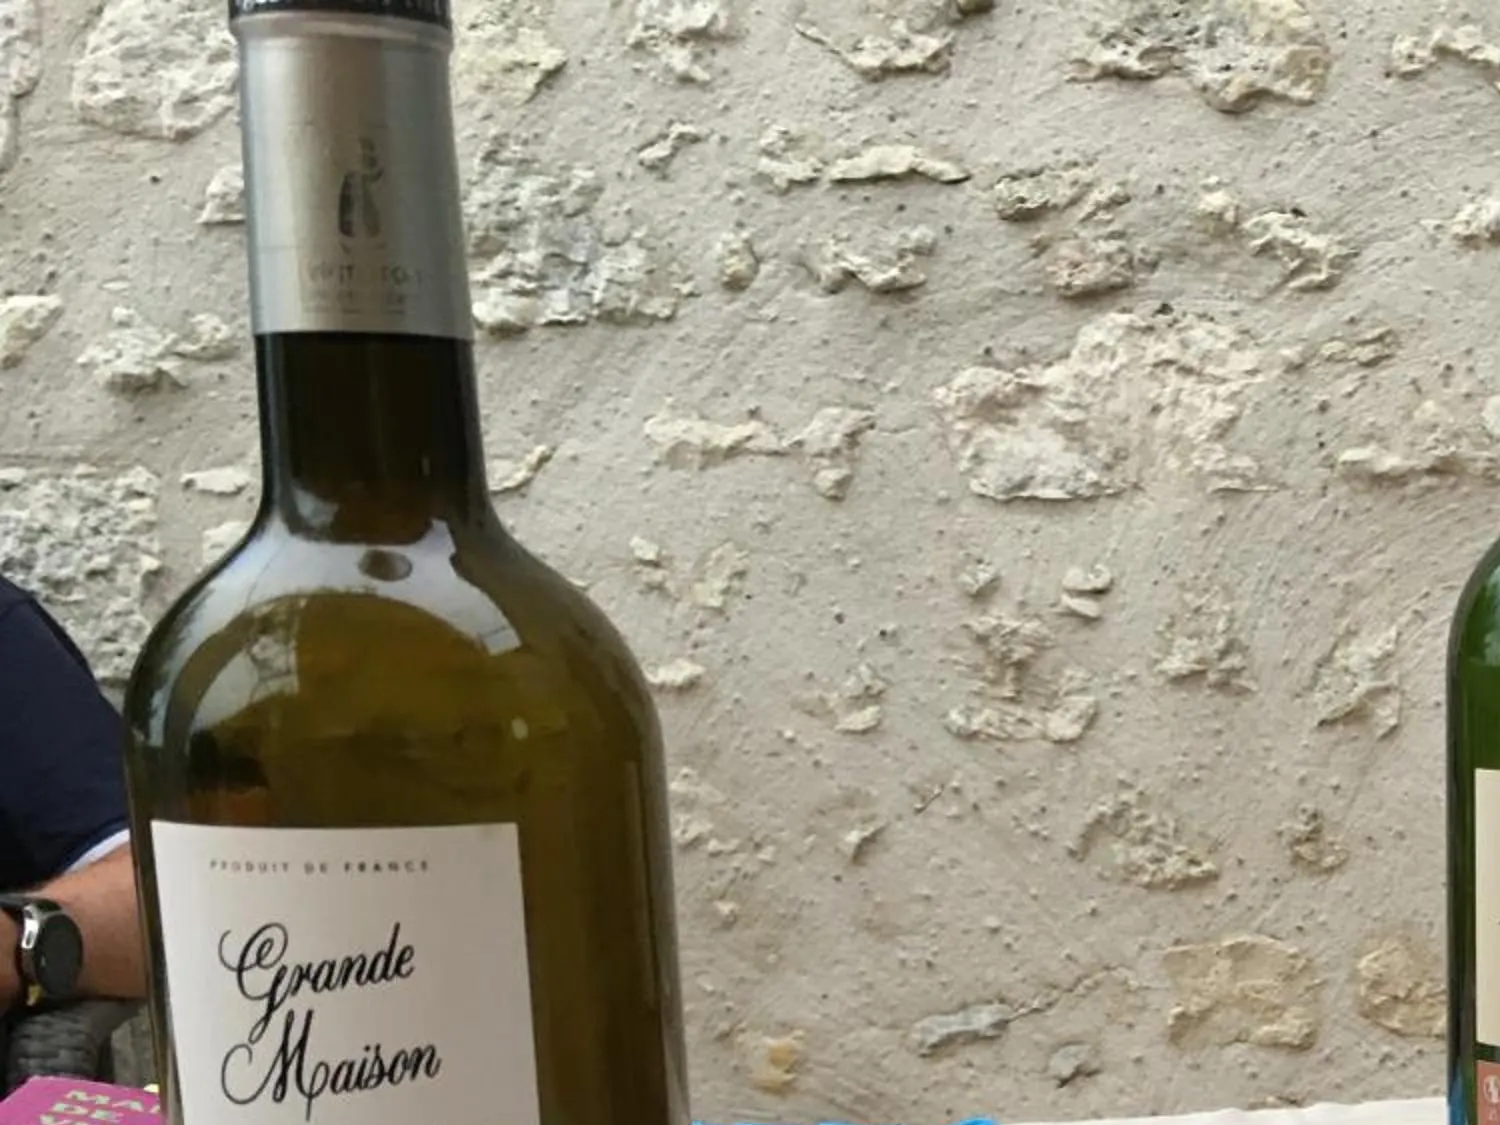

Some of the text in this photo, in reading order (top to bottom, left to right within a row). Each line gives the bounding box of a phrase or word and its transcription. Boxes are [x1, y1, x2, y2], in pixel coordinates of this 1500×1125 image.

[210, 860, 428, 874] PRODUIT DE FRANCE
[217, 920, 415, 1045] Grande
[220, 1009, 441, 1122] Maison
